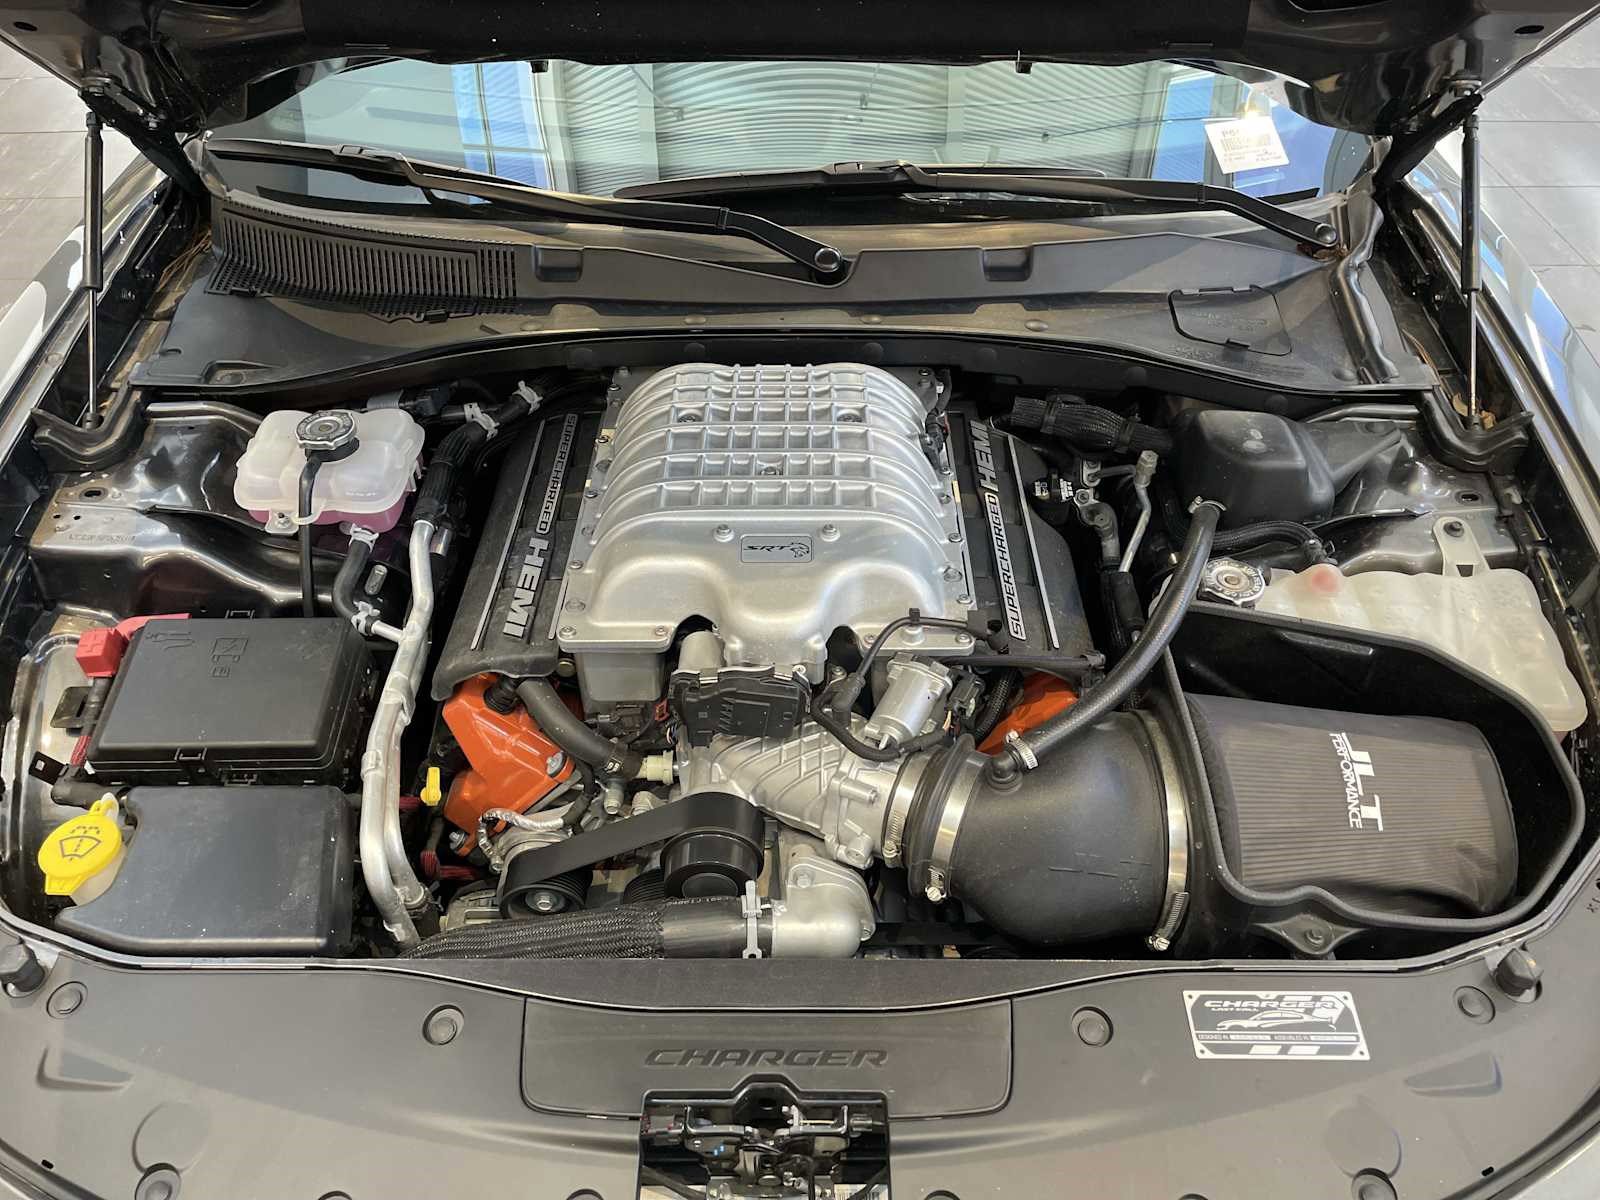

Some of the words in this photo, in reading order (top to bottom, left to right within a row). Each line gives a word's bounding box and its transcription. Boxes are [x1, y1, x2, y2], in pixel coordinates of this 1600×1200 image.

[538, 414, 577, 533] SUPERCHARGED
[970, 420, 999, 492] HEMI
[503, 537, 549, 638] HEMI
[743, 545, 791, 553] SRT
[986, 493, 1026, 640] SUPERCHARGED
[1328, 732, 1363, 829] PERFORMANCE
[1341, 732, 1384, 832] JLT
[1204, 1000, 1338, 1008] CHARGER
[644, 1049, 890, 1068] CHARGER
